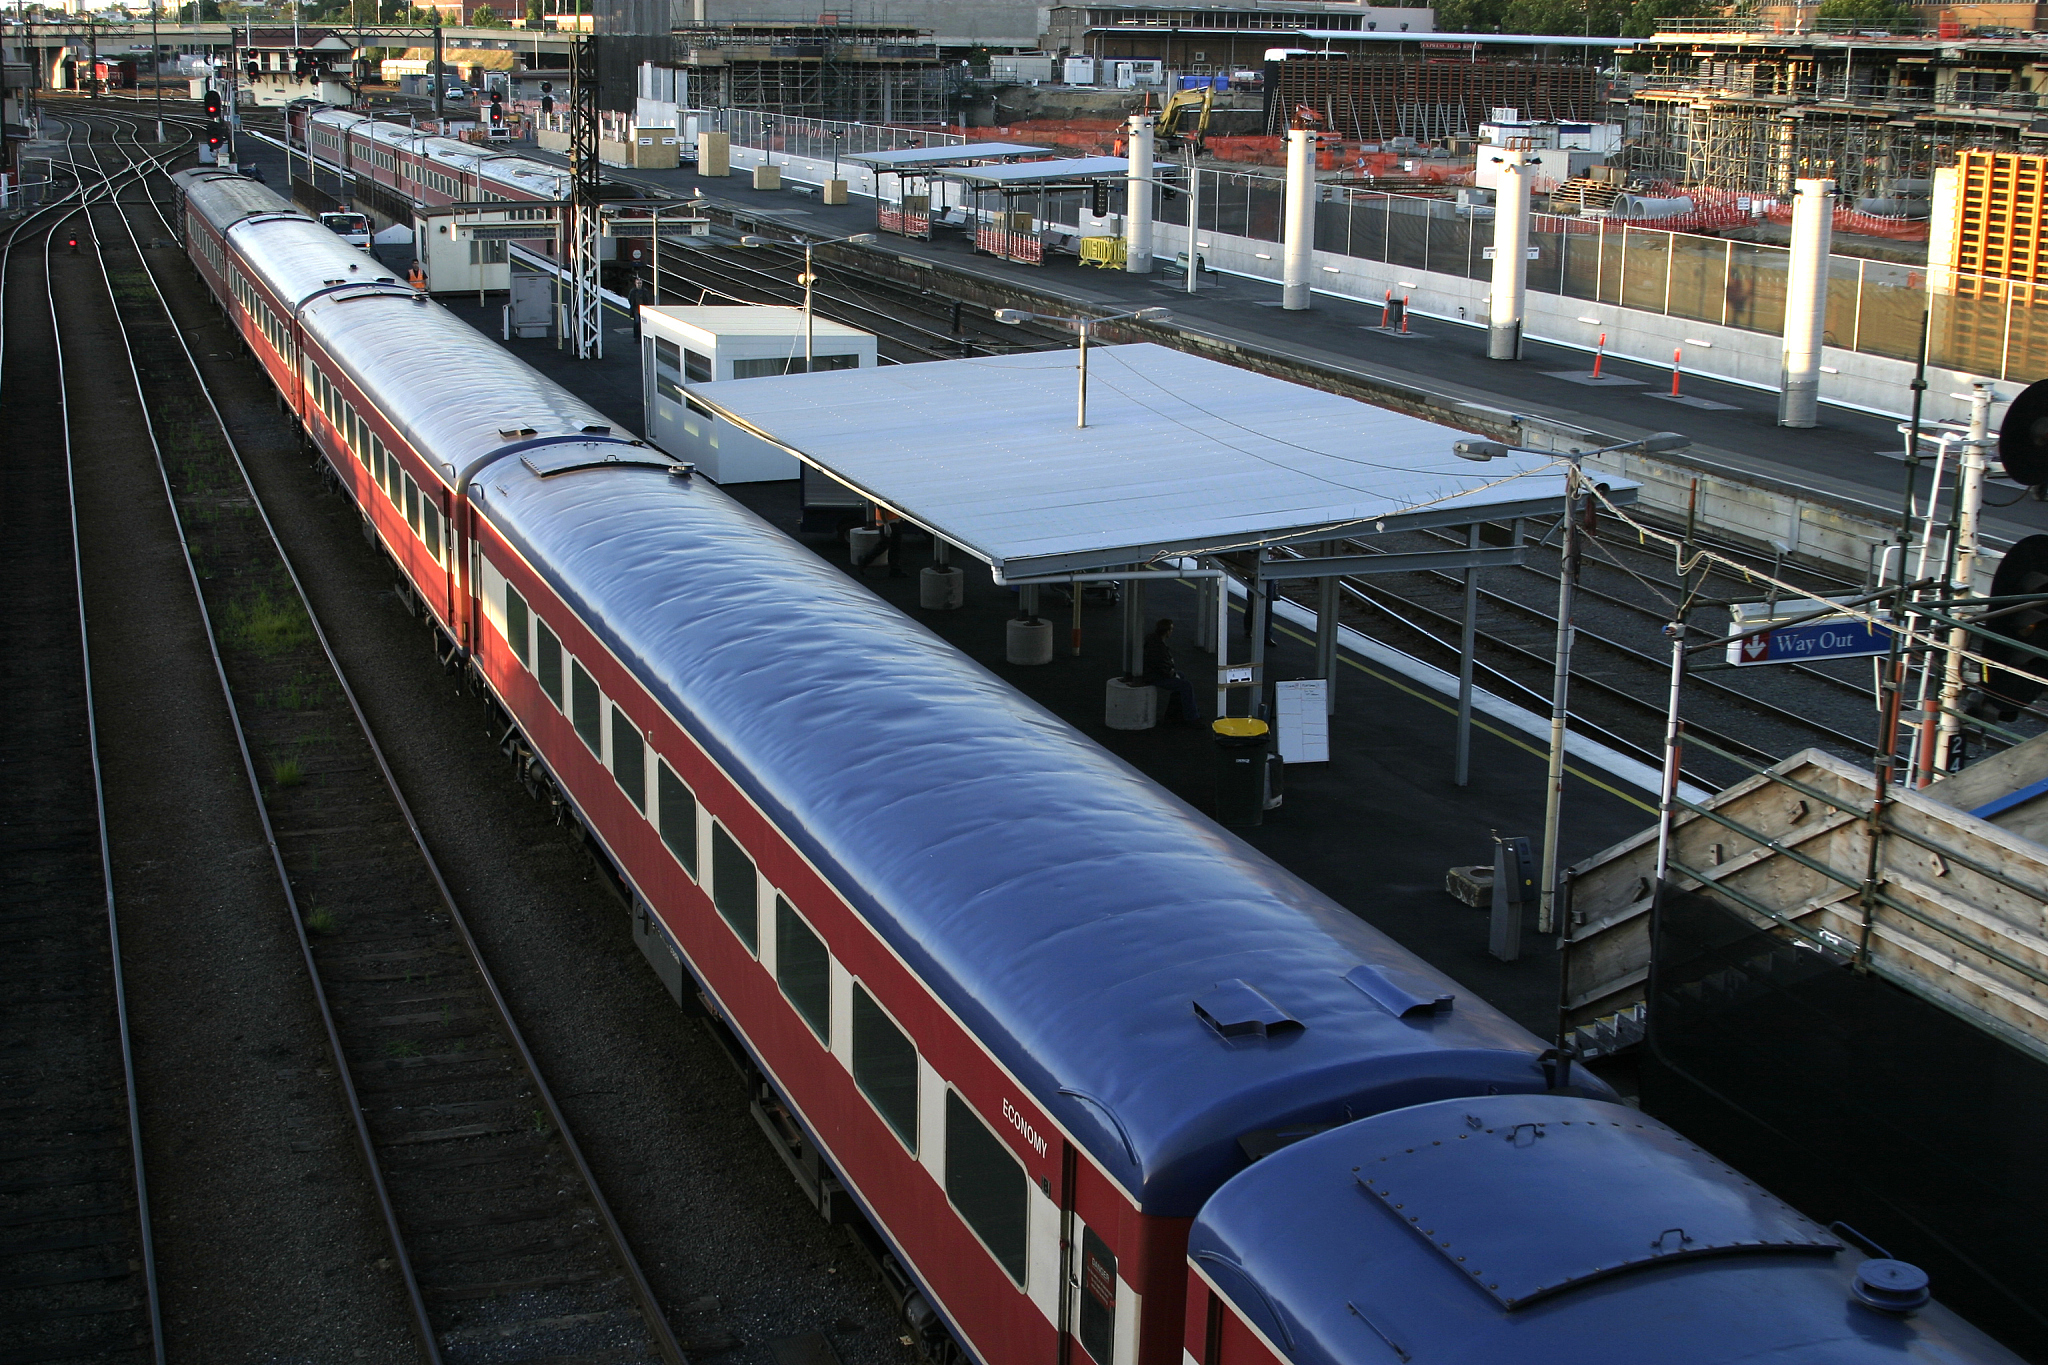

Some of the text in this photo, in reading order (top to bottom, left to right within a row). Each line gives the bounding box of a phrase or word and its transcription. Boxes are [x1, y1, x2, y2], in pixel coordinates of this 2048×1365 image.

[1776, 631, 1854, 654] Way Out
[1002, 1097, 1048, 1159] ECONOMY
